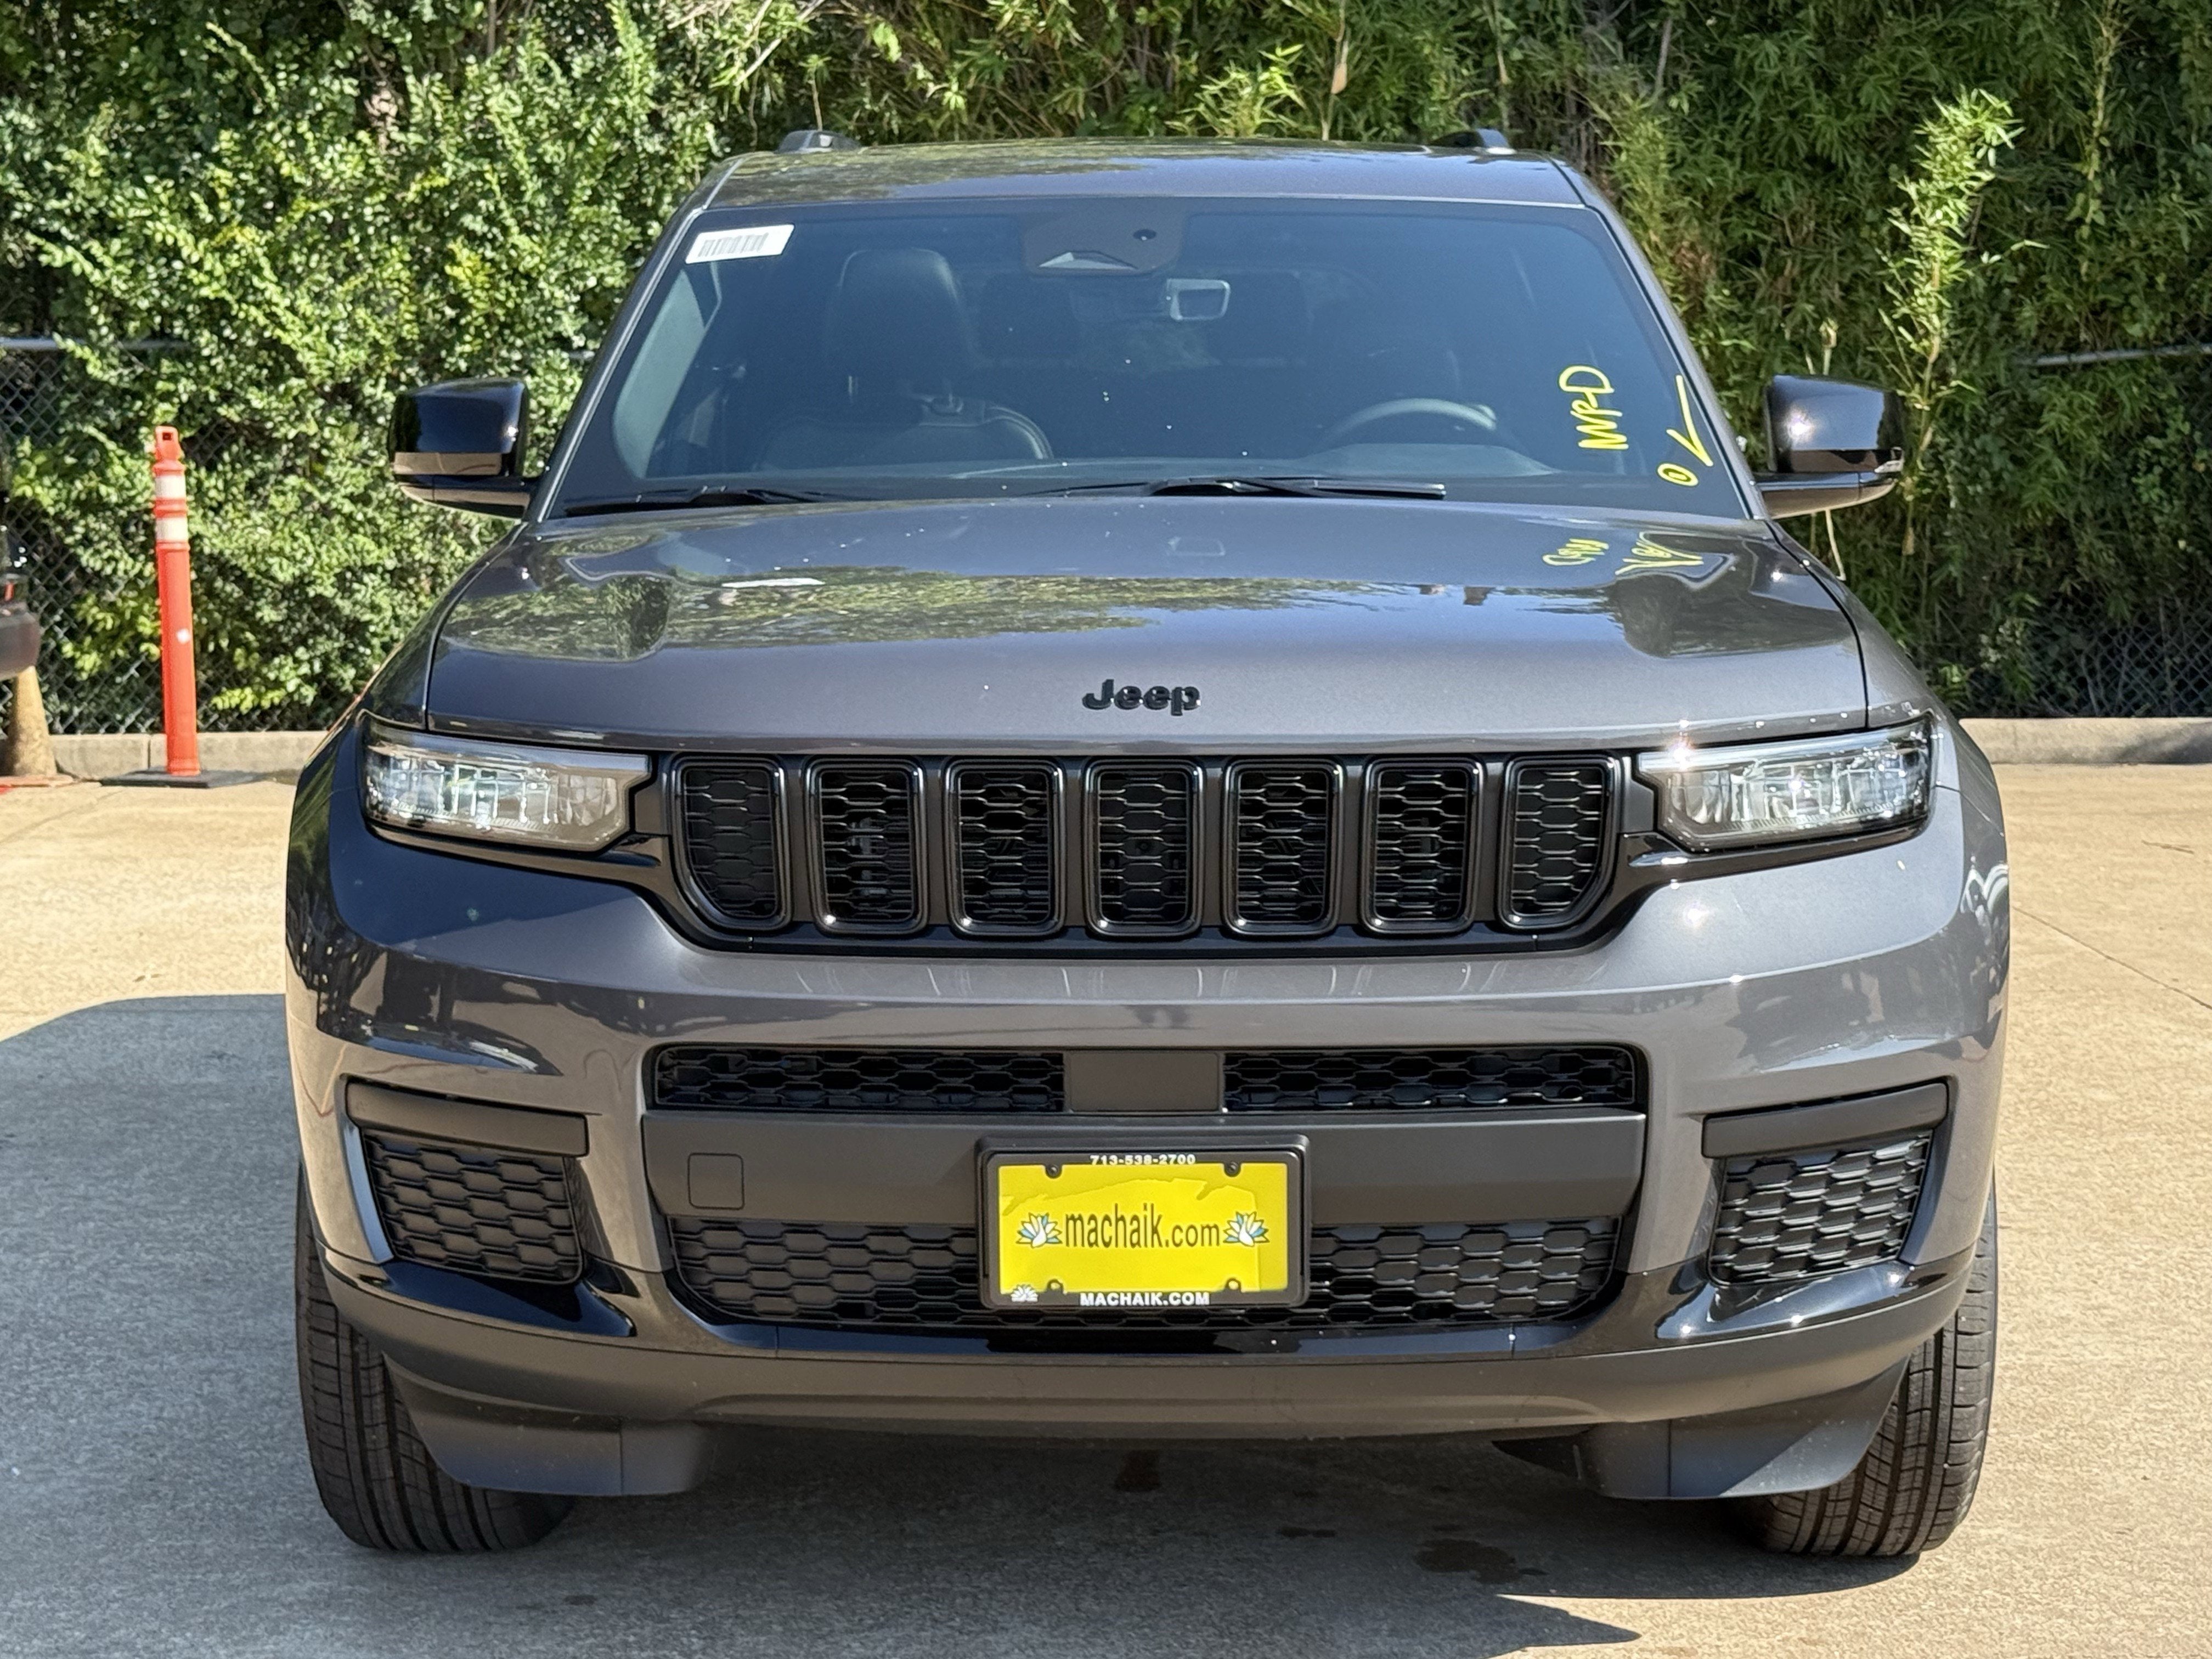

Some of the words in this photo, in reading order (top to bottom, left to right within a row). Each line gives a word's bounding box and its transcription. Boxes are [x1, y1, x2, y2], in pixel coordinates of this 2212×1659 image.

[1082, 679, 1201, 716] Jeep
[1090, 1154, 1195, 1165] 713-538-2700
[1065, 1203, 1220, 1248] machaik.com
[1080, 1292, 1210, 1306] MACHAIK.COM
